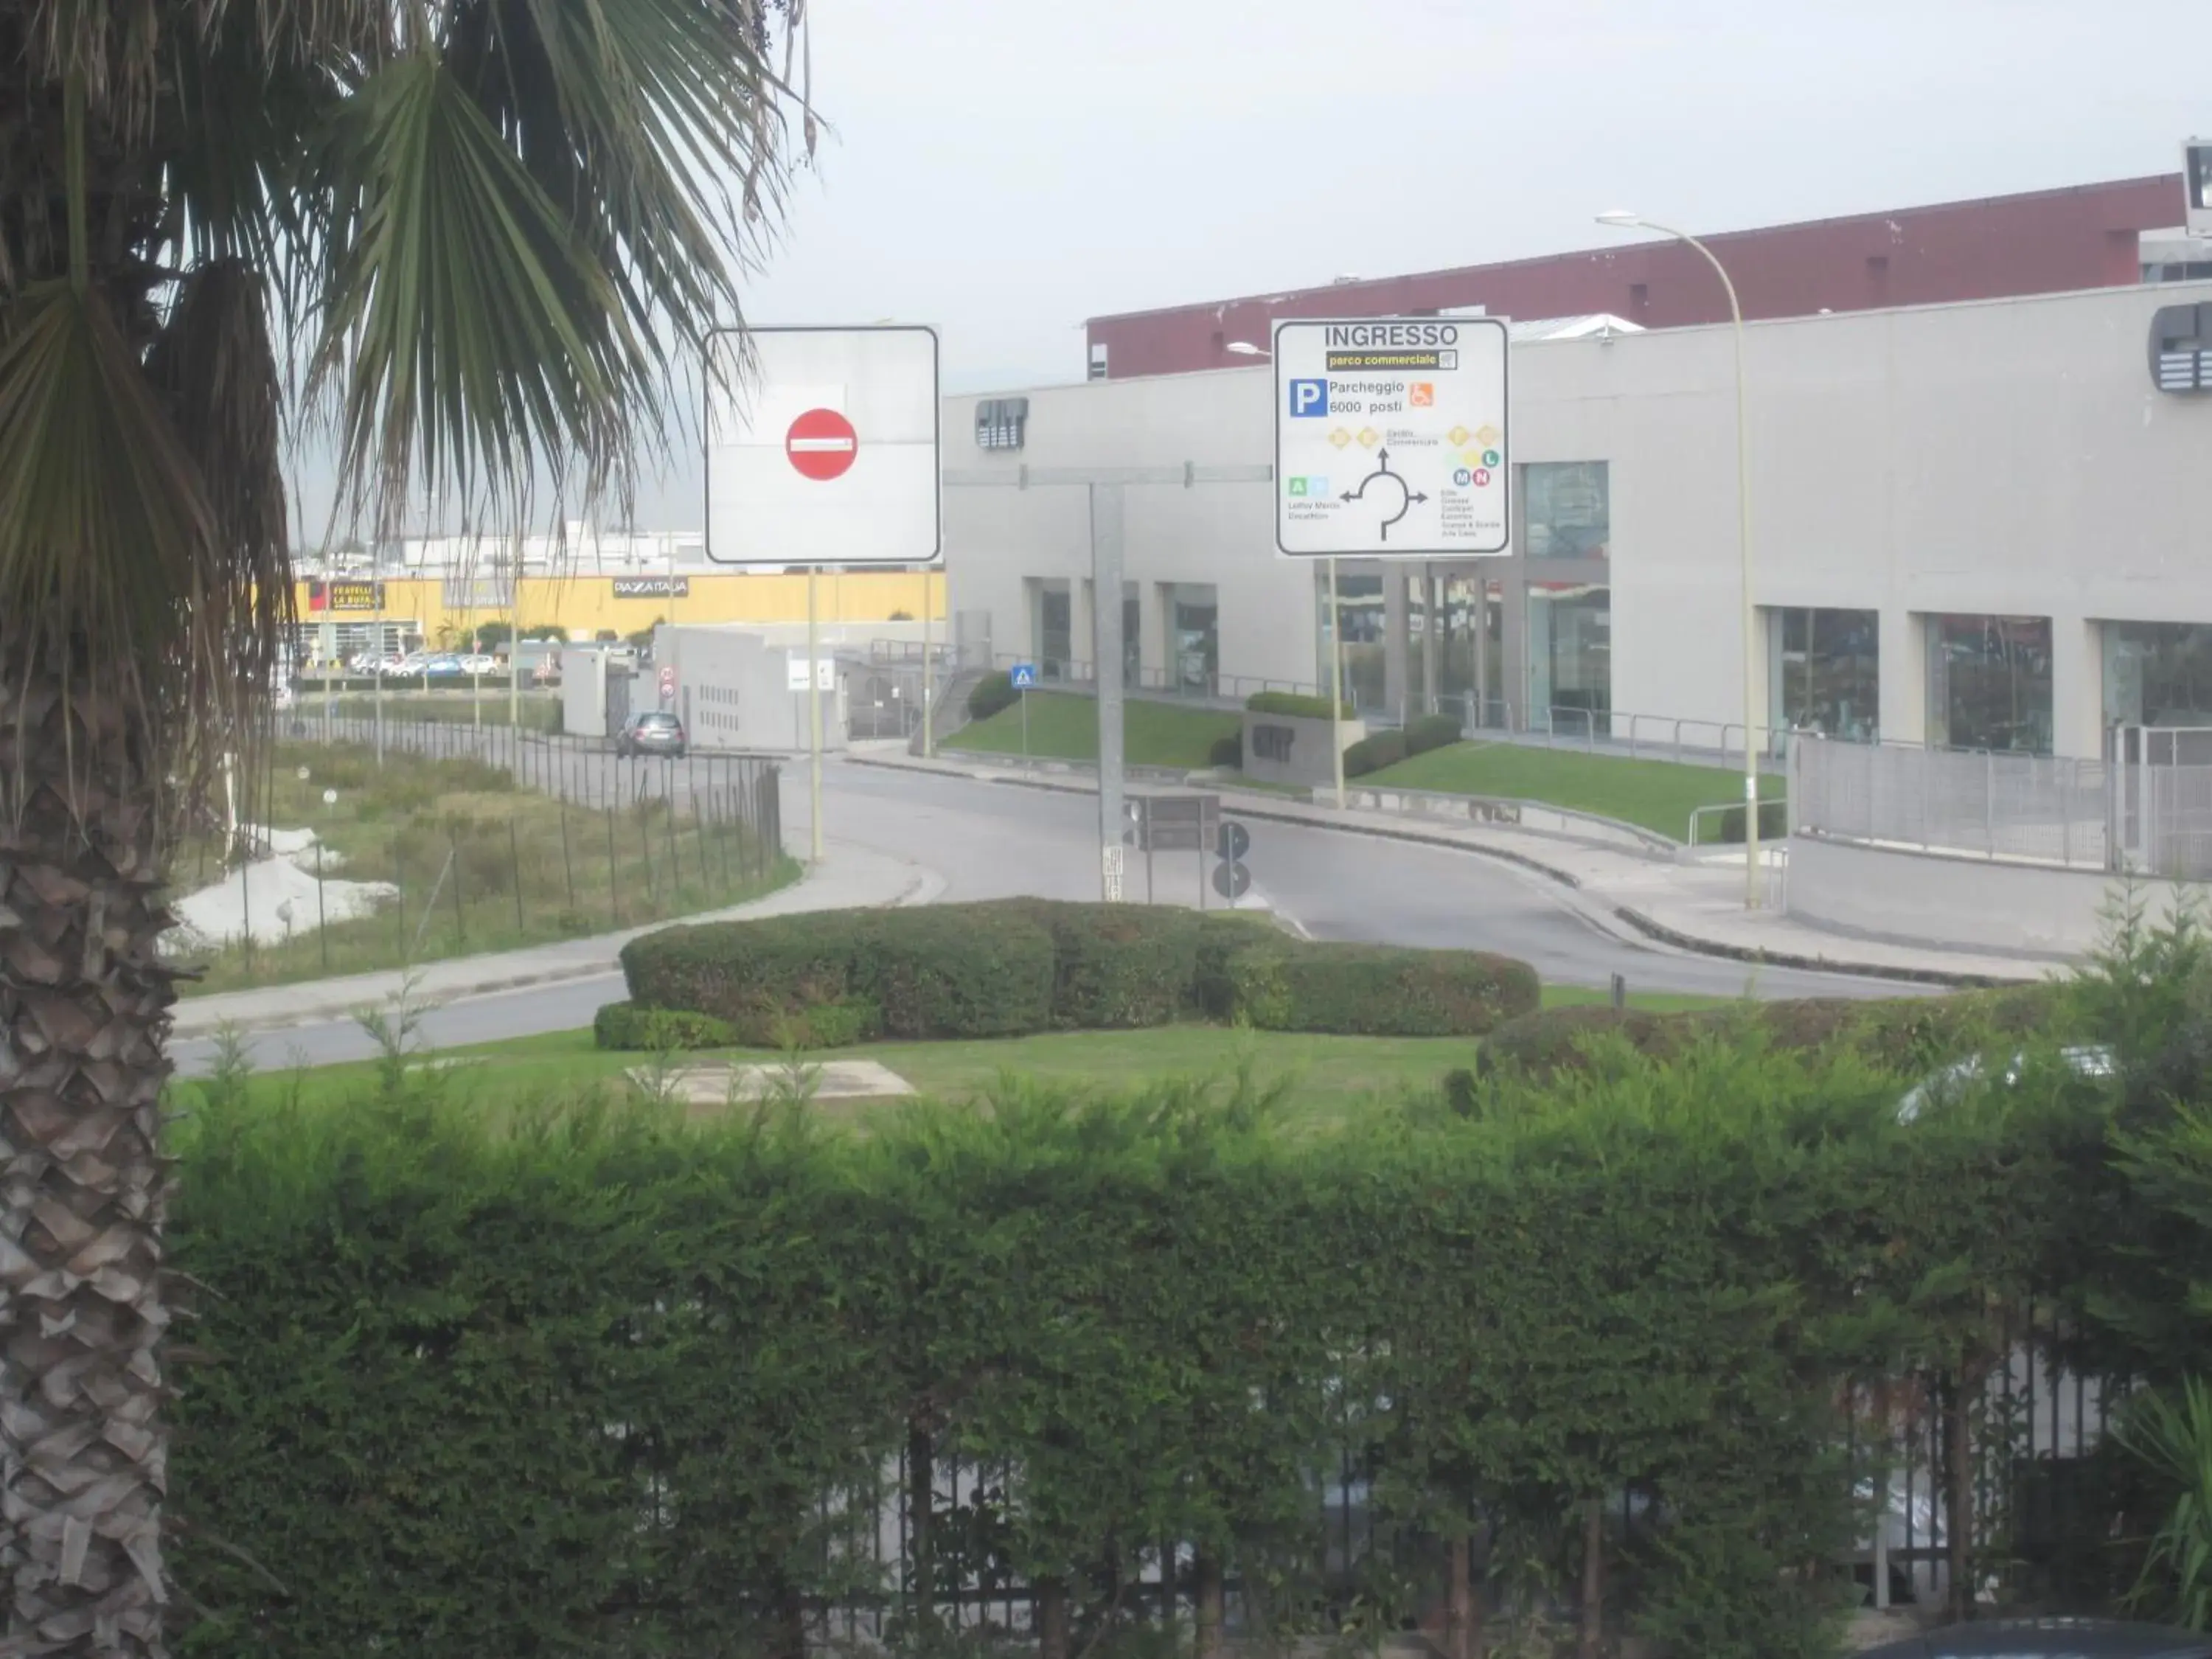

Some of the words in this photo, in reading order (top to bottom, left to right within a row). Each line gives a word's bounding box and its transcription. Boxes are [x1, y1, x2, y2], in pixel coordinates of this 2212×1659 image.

[1325, 325, 1458, 347] INGRESSO
[1329, 357, 1362, 367] parco
[1365, 354, 1437, 365] commerciale
[1329, 381, 1405, 394] Parcheggio
[1297, 383, 1321, 414] P
[1329, 402, 1362, 413] 6000
[1369, 400, 1402, 414] posti
